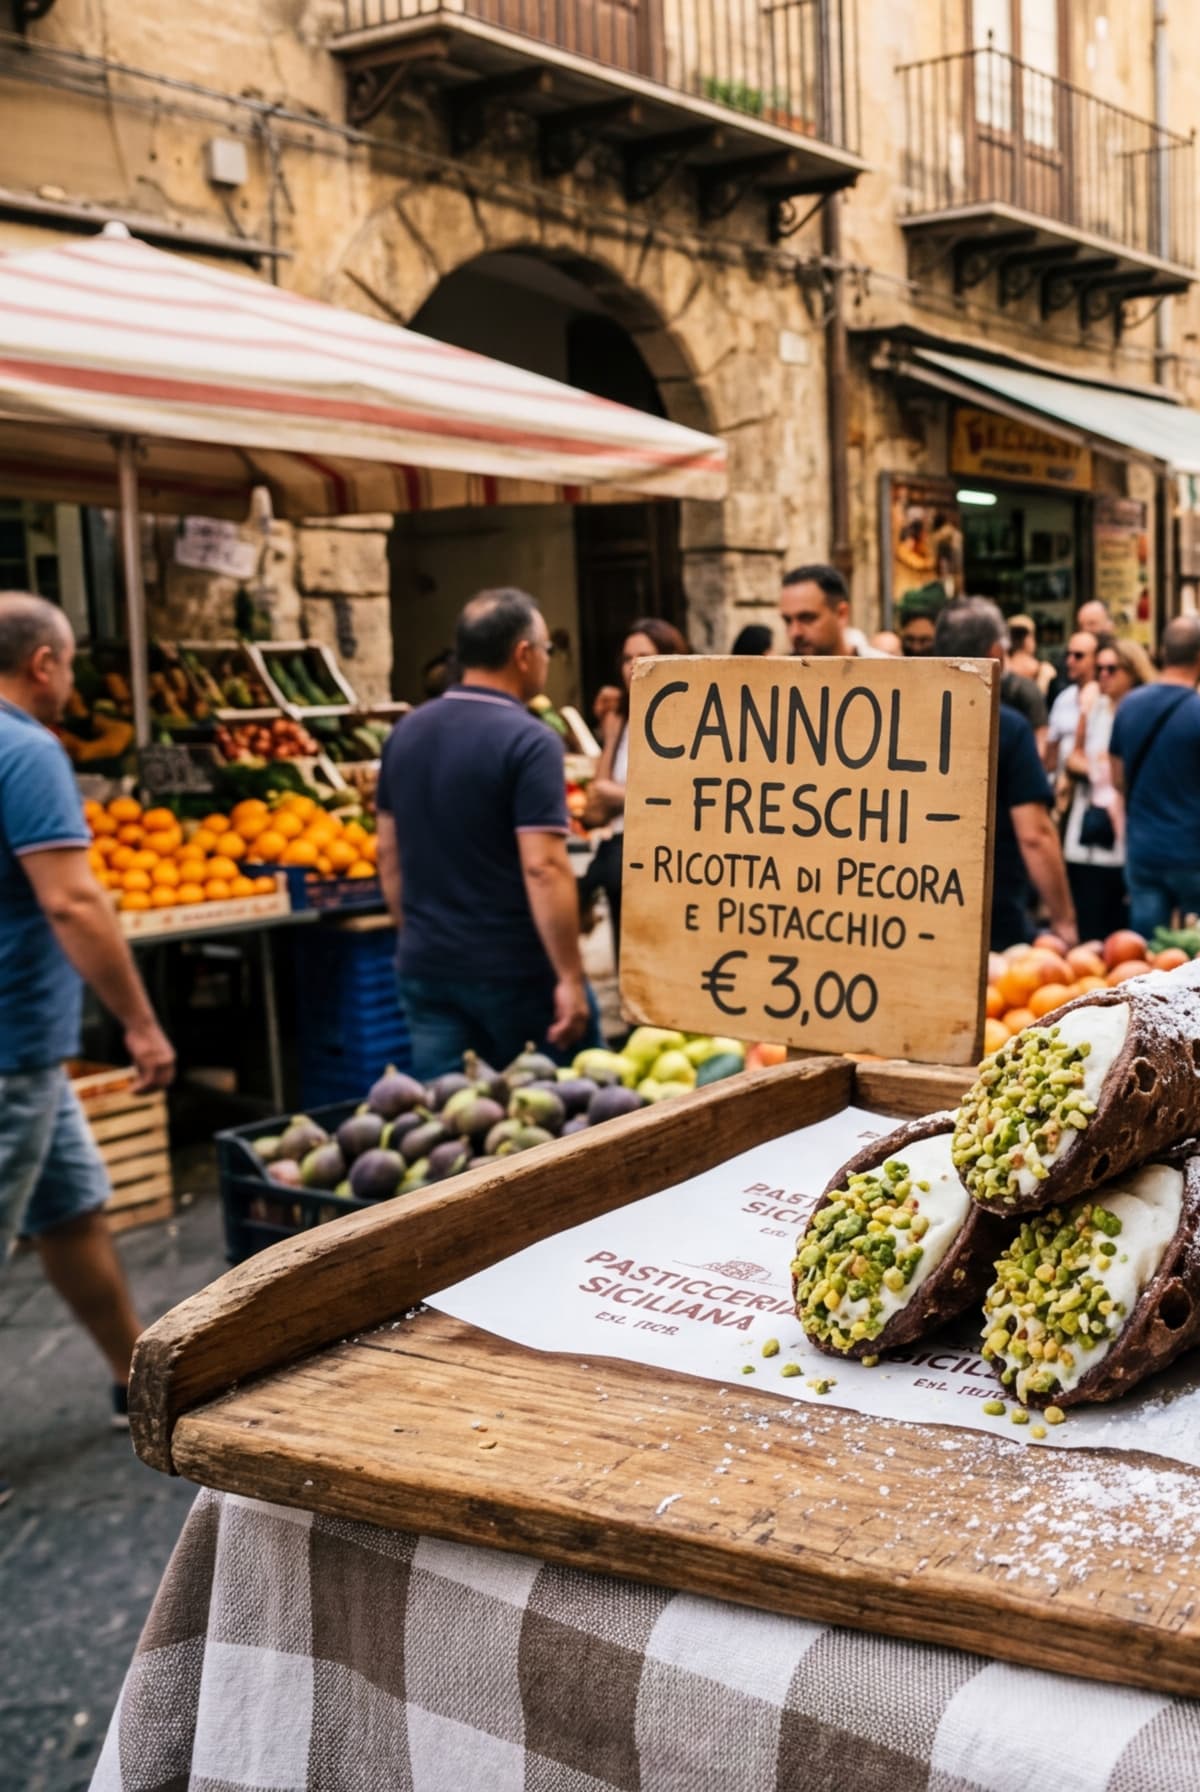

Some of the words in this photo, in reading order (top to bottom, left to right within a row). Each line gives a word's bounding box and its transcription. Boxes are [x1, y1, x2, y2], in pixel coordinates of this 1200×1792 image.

[644, 681, 952, 775] CANNOLI
[692, 778, 909, 844] FRESCHI
[653, 845, 781, 891] RICOTTA
[837, 857, 965, 906] PECORA
[718, 898, 906, 949] PISTACCHIO
[701, 950, 748, 1016] €
[763, 954, 879, 1026] 3,00
[578, 1276, 755, 1331] SICILIANA
